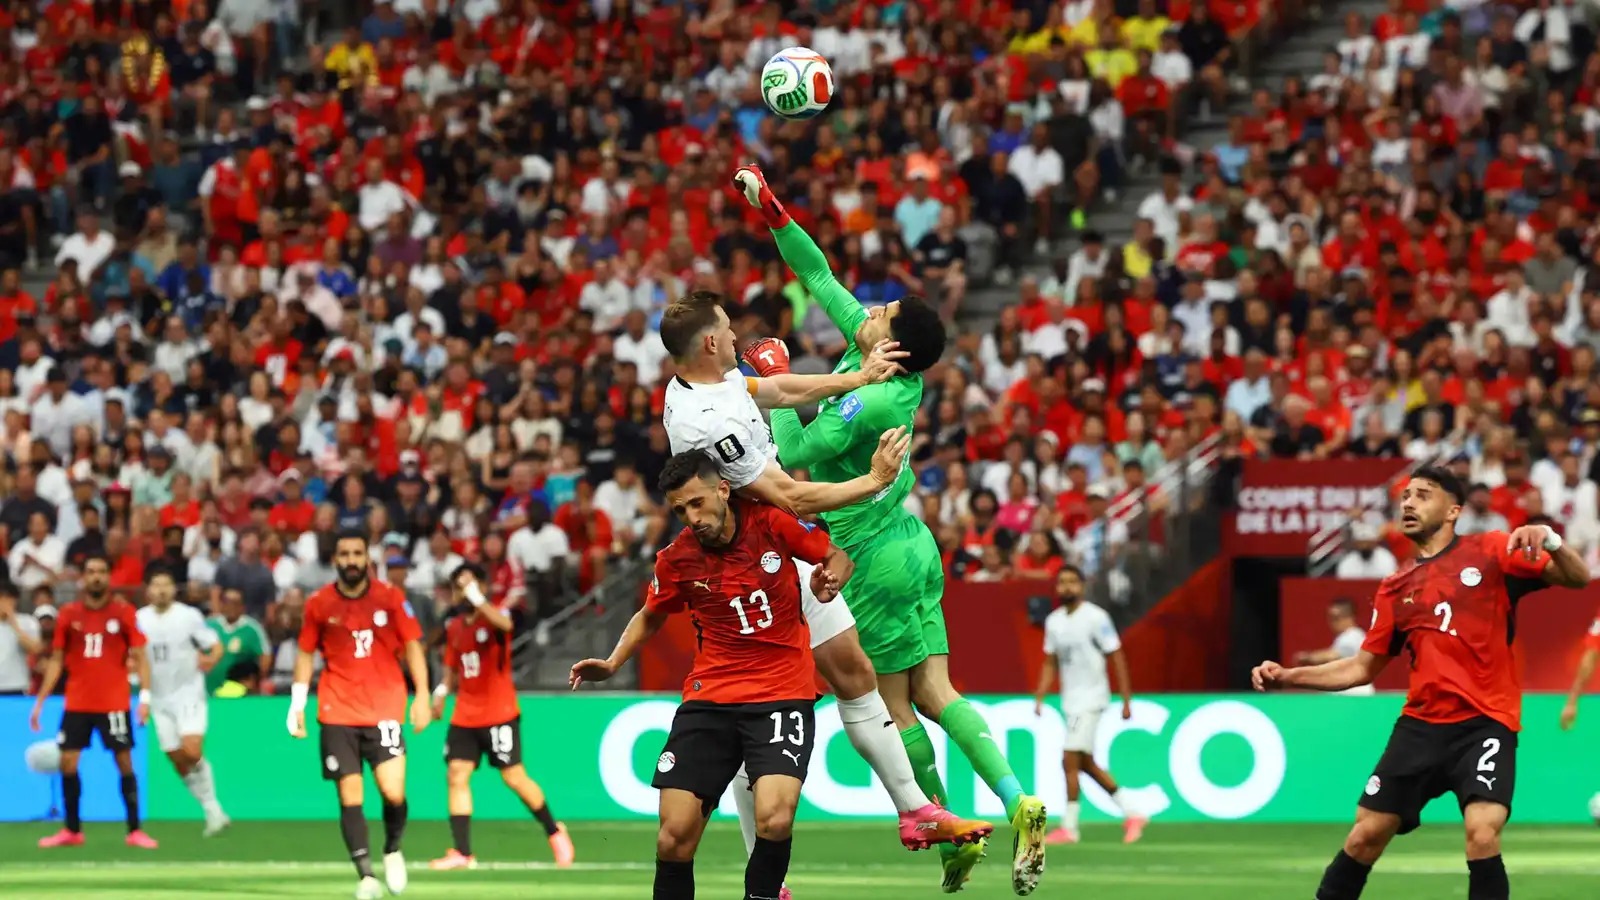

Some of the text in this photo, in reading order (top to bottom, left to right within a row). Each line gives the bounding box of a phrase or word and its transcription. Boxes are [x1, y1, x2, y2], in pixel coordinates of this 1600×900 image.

[1272, 511, 1301, 533] LA
[729, 589, 773, 634] 13
[83, 633, 103, 658] 11
[352, 629, 373, 658] 17
[108, 711, 127, 735] 11
[377, 719, 401, 747] 17
[769, 711, 804, 746] 13
[490, 725, 513, 753] 19
[599, 699, 1286, 820] aamco
[1477, 738, 1500, 771] 2
